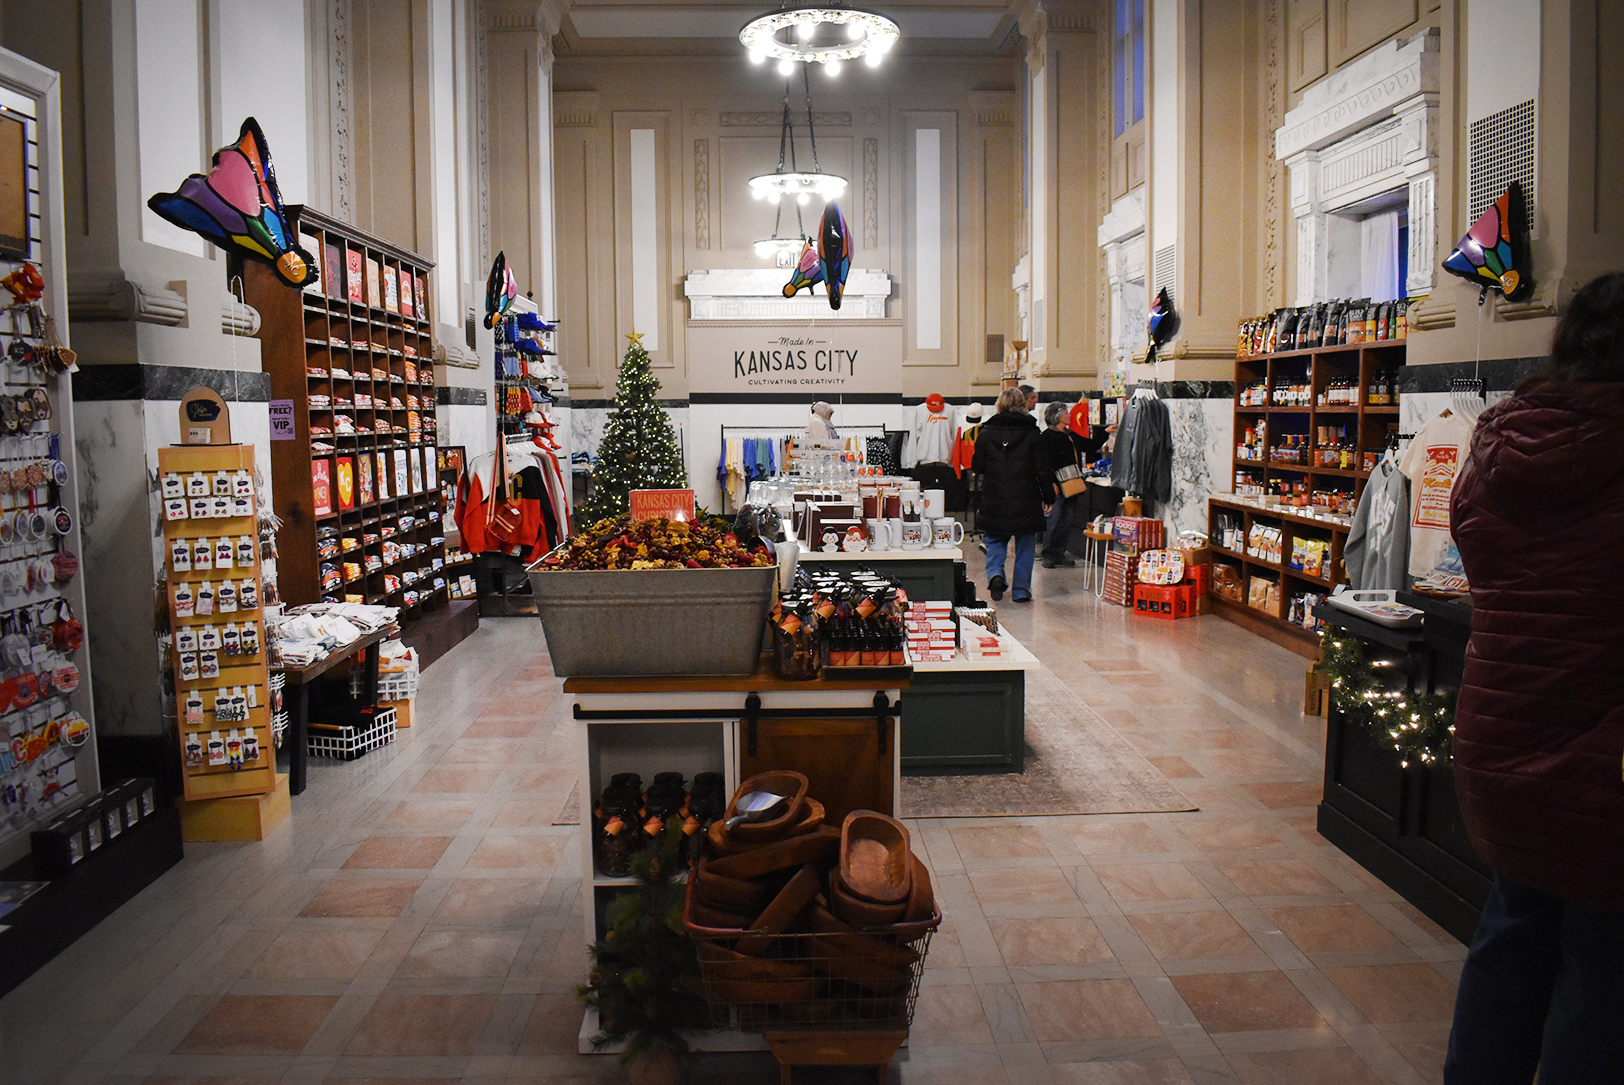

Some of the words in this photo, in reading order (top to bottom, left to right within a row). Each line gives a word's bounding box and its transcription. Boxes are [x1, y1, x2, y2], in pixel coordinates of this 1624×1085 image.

[778, 337, 804, 347] Made
[805, 337, 814, 346] In
[734, 350, 807, 379] KANSAS
[815, 349, 858, 376] CITY
[269, 407, 292, 415] FREE?
[273, 420, 290, 430] VIP
[340, 471, 352, 492] KC
[636, 493, 670, 509] KANSAS
[671, 493, 690, 508] CITY
